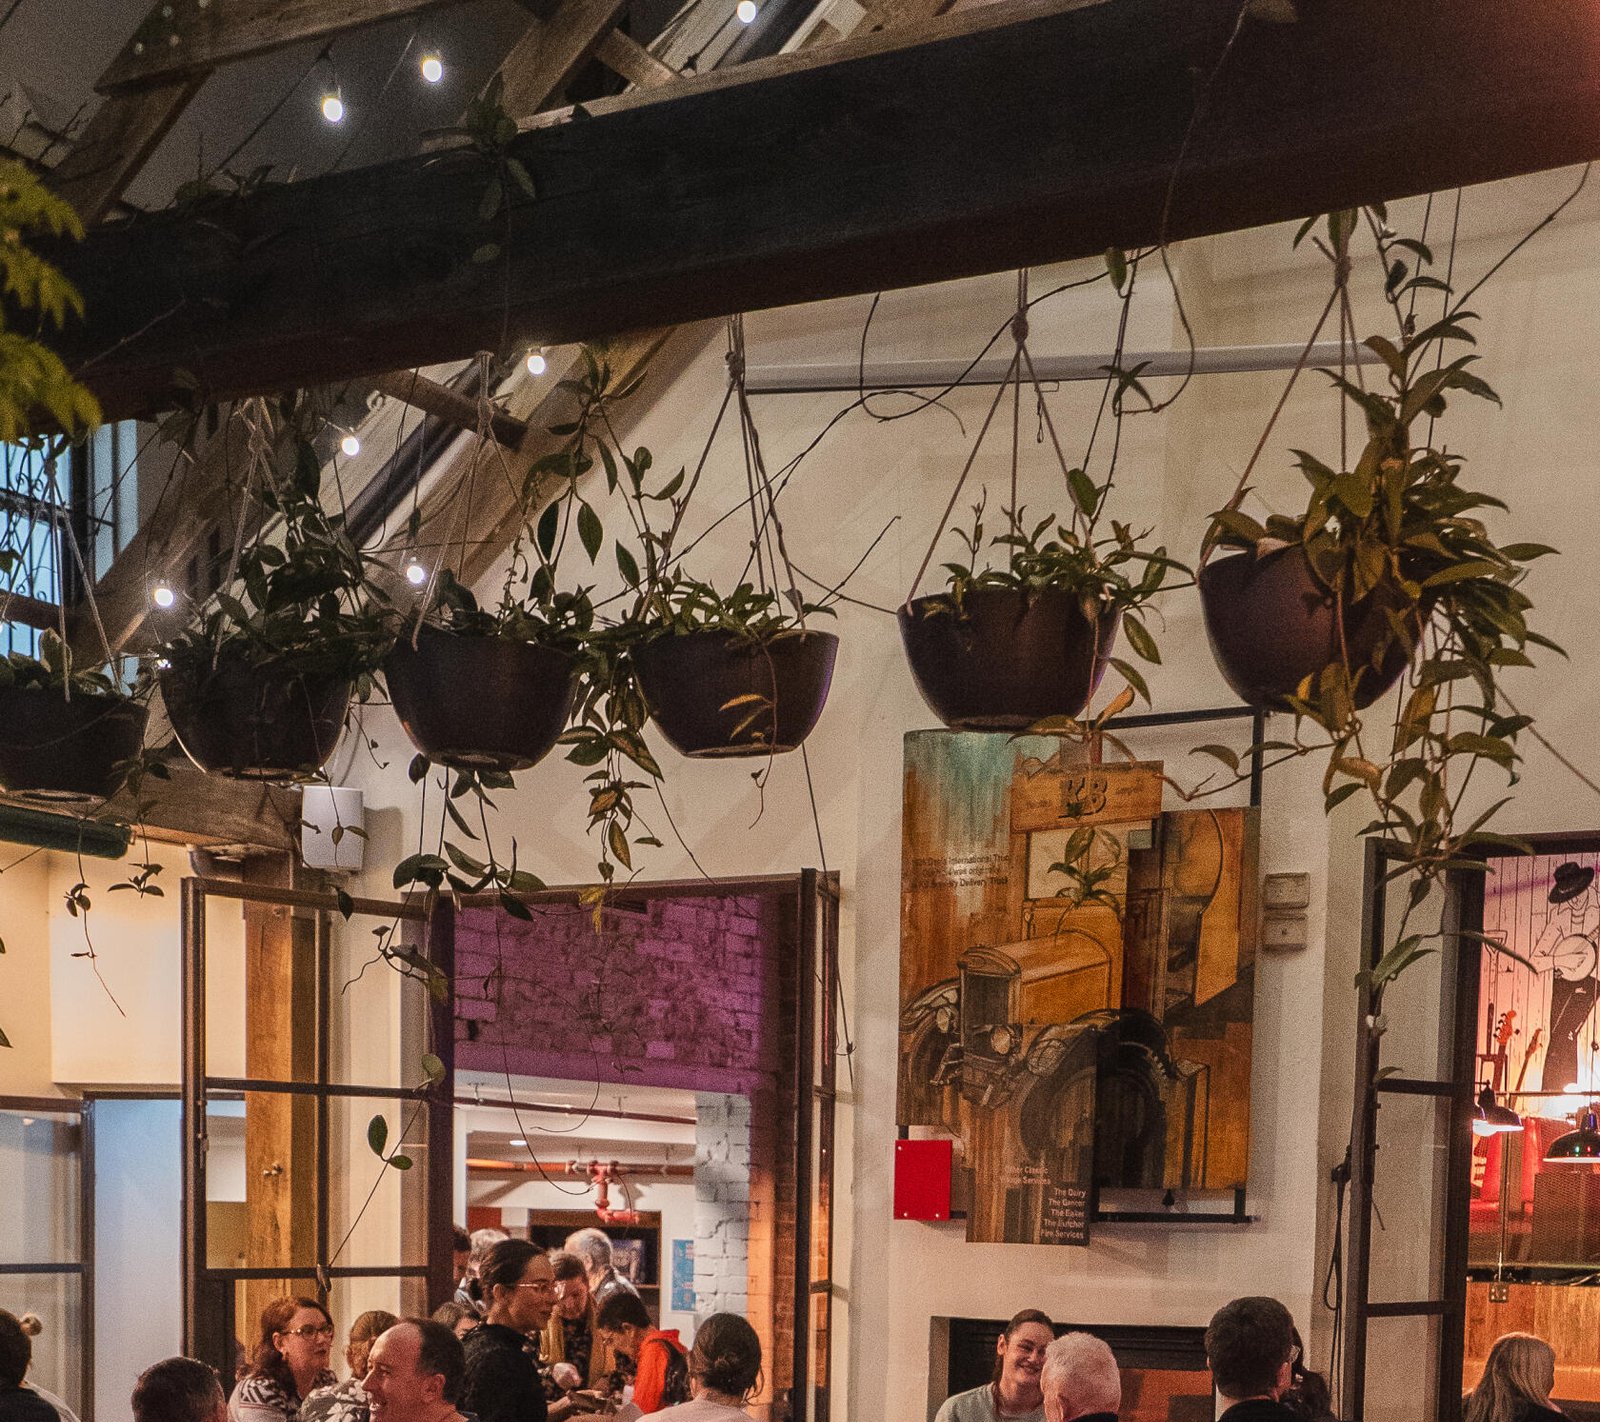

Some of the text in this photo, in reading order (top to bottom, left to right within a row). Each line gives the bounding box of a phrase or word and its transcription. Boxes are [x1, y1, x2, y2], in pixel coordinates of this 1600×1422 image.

[1054, 1188, 1067, 1197] The
[1048, 1198, 1061, 1207] The
[1051, 1208, 1063, 1217] The
[1044, 1218, 1057, 1227] The
